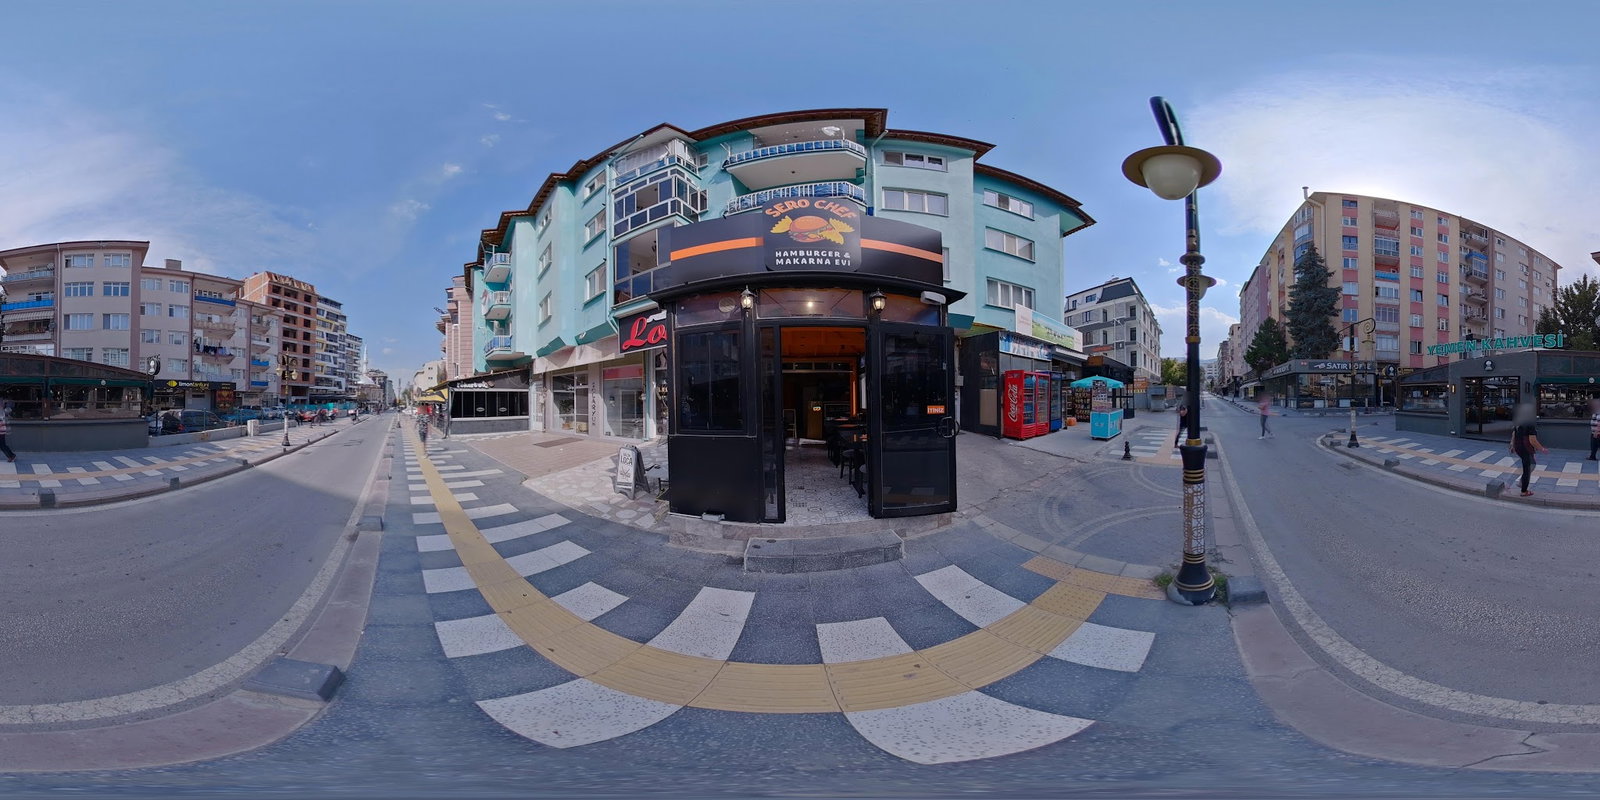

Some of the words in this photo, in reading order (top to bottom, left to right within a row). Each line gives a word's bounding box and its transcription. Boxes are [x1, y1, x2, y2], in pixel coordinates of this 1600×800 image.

[765, 199, 810, 217] SERO
[814, 200, 857, 218] CHEF
[775, 250, 841, 258] HAMBURGER
[775, 258, 831, 266] MAKARNA
[1427, 340, 1477, 356] YEMEN
[1481, 329, 1564, 349] KAHVESİ
